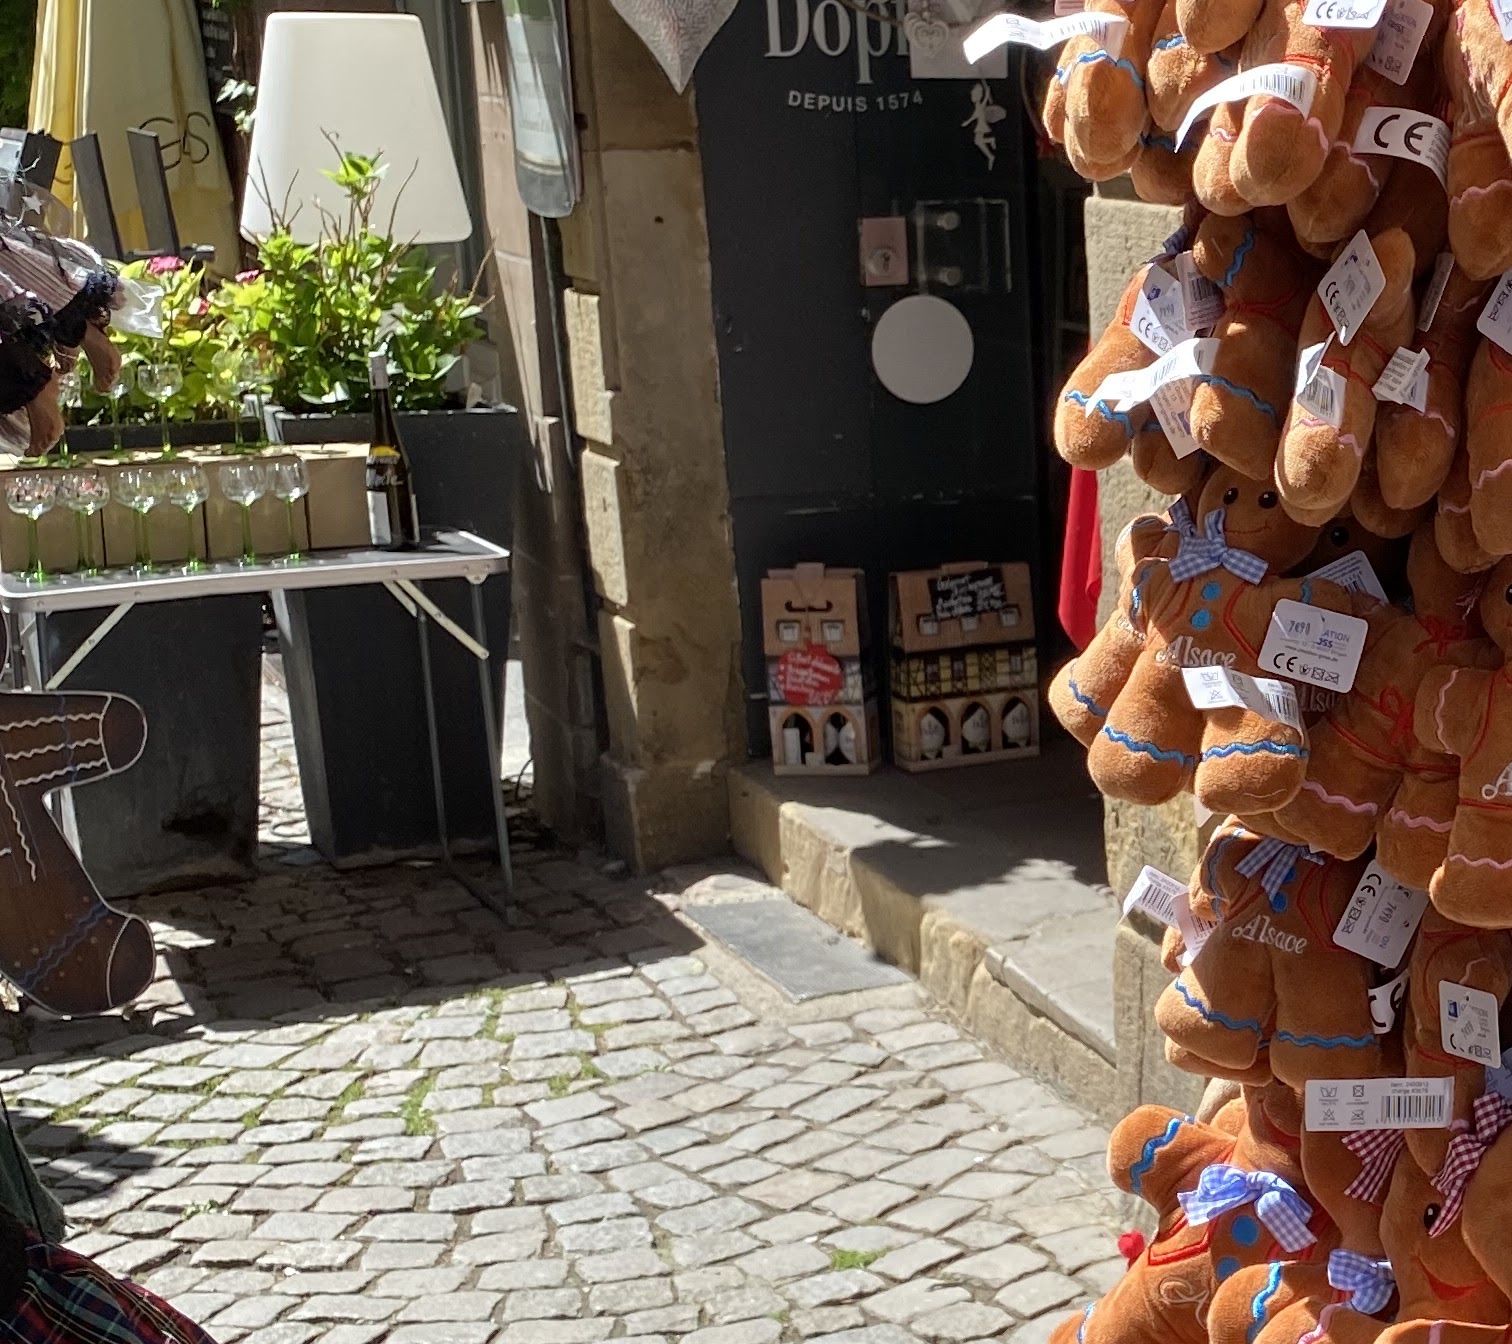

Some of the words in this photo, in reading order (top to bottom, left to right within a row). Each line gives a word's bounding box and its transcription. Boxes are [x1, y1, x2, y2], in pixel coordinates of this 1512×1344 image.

[787, 89, 868, 113] DEPUIS
[875, 89, 924, 112] 1574
[1373, 114, 1433, 156] CE
[1273, 652, 1299, 673] CE
[1360, 872, 1382, 898] CE
[1231, 913, 1308, 955] Alsace
